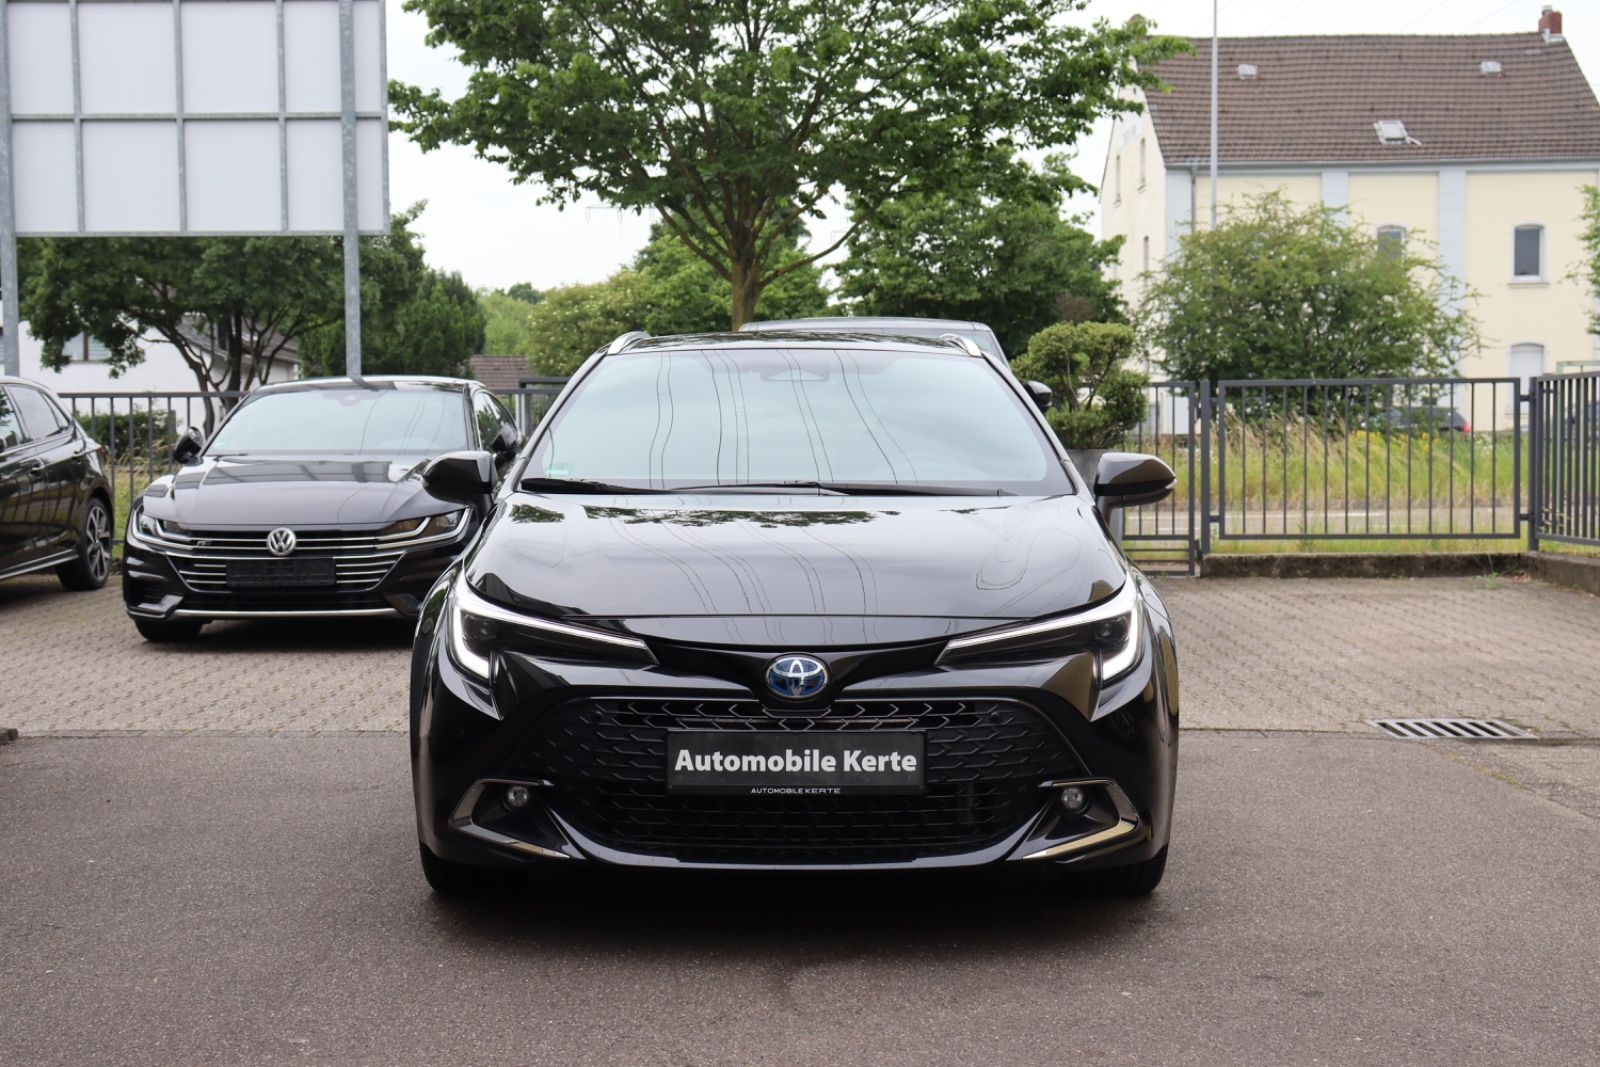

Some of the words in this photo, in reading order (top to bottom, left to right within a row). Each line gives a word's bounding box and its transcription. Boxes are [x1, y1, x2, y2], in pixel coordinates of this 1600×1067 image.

[268, 528, 296, 556] VW
[674, 749, 836, 772] Automobile
[843, 750, 917, 772] Kerte
